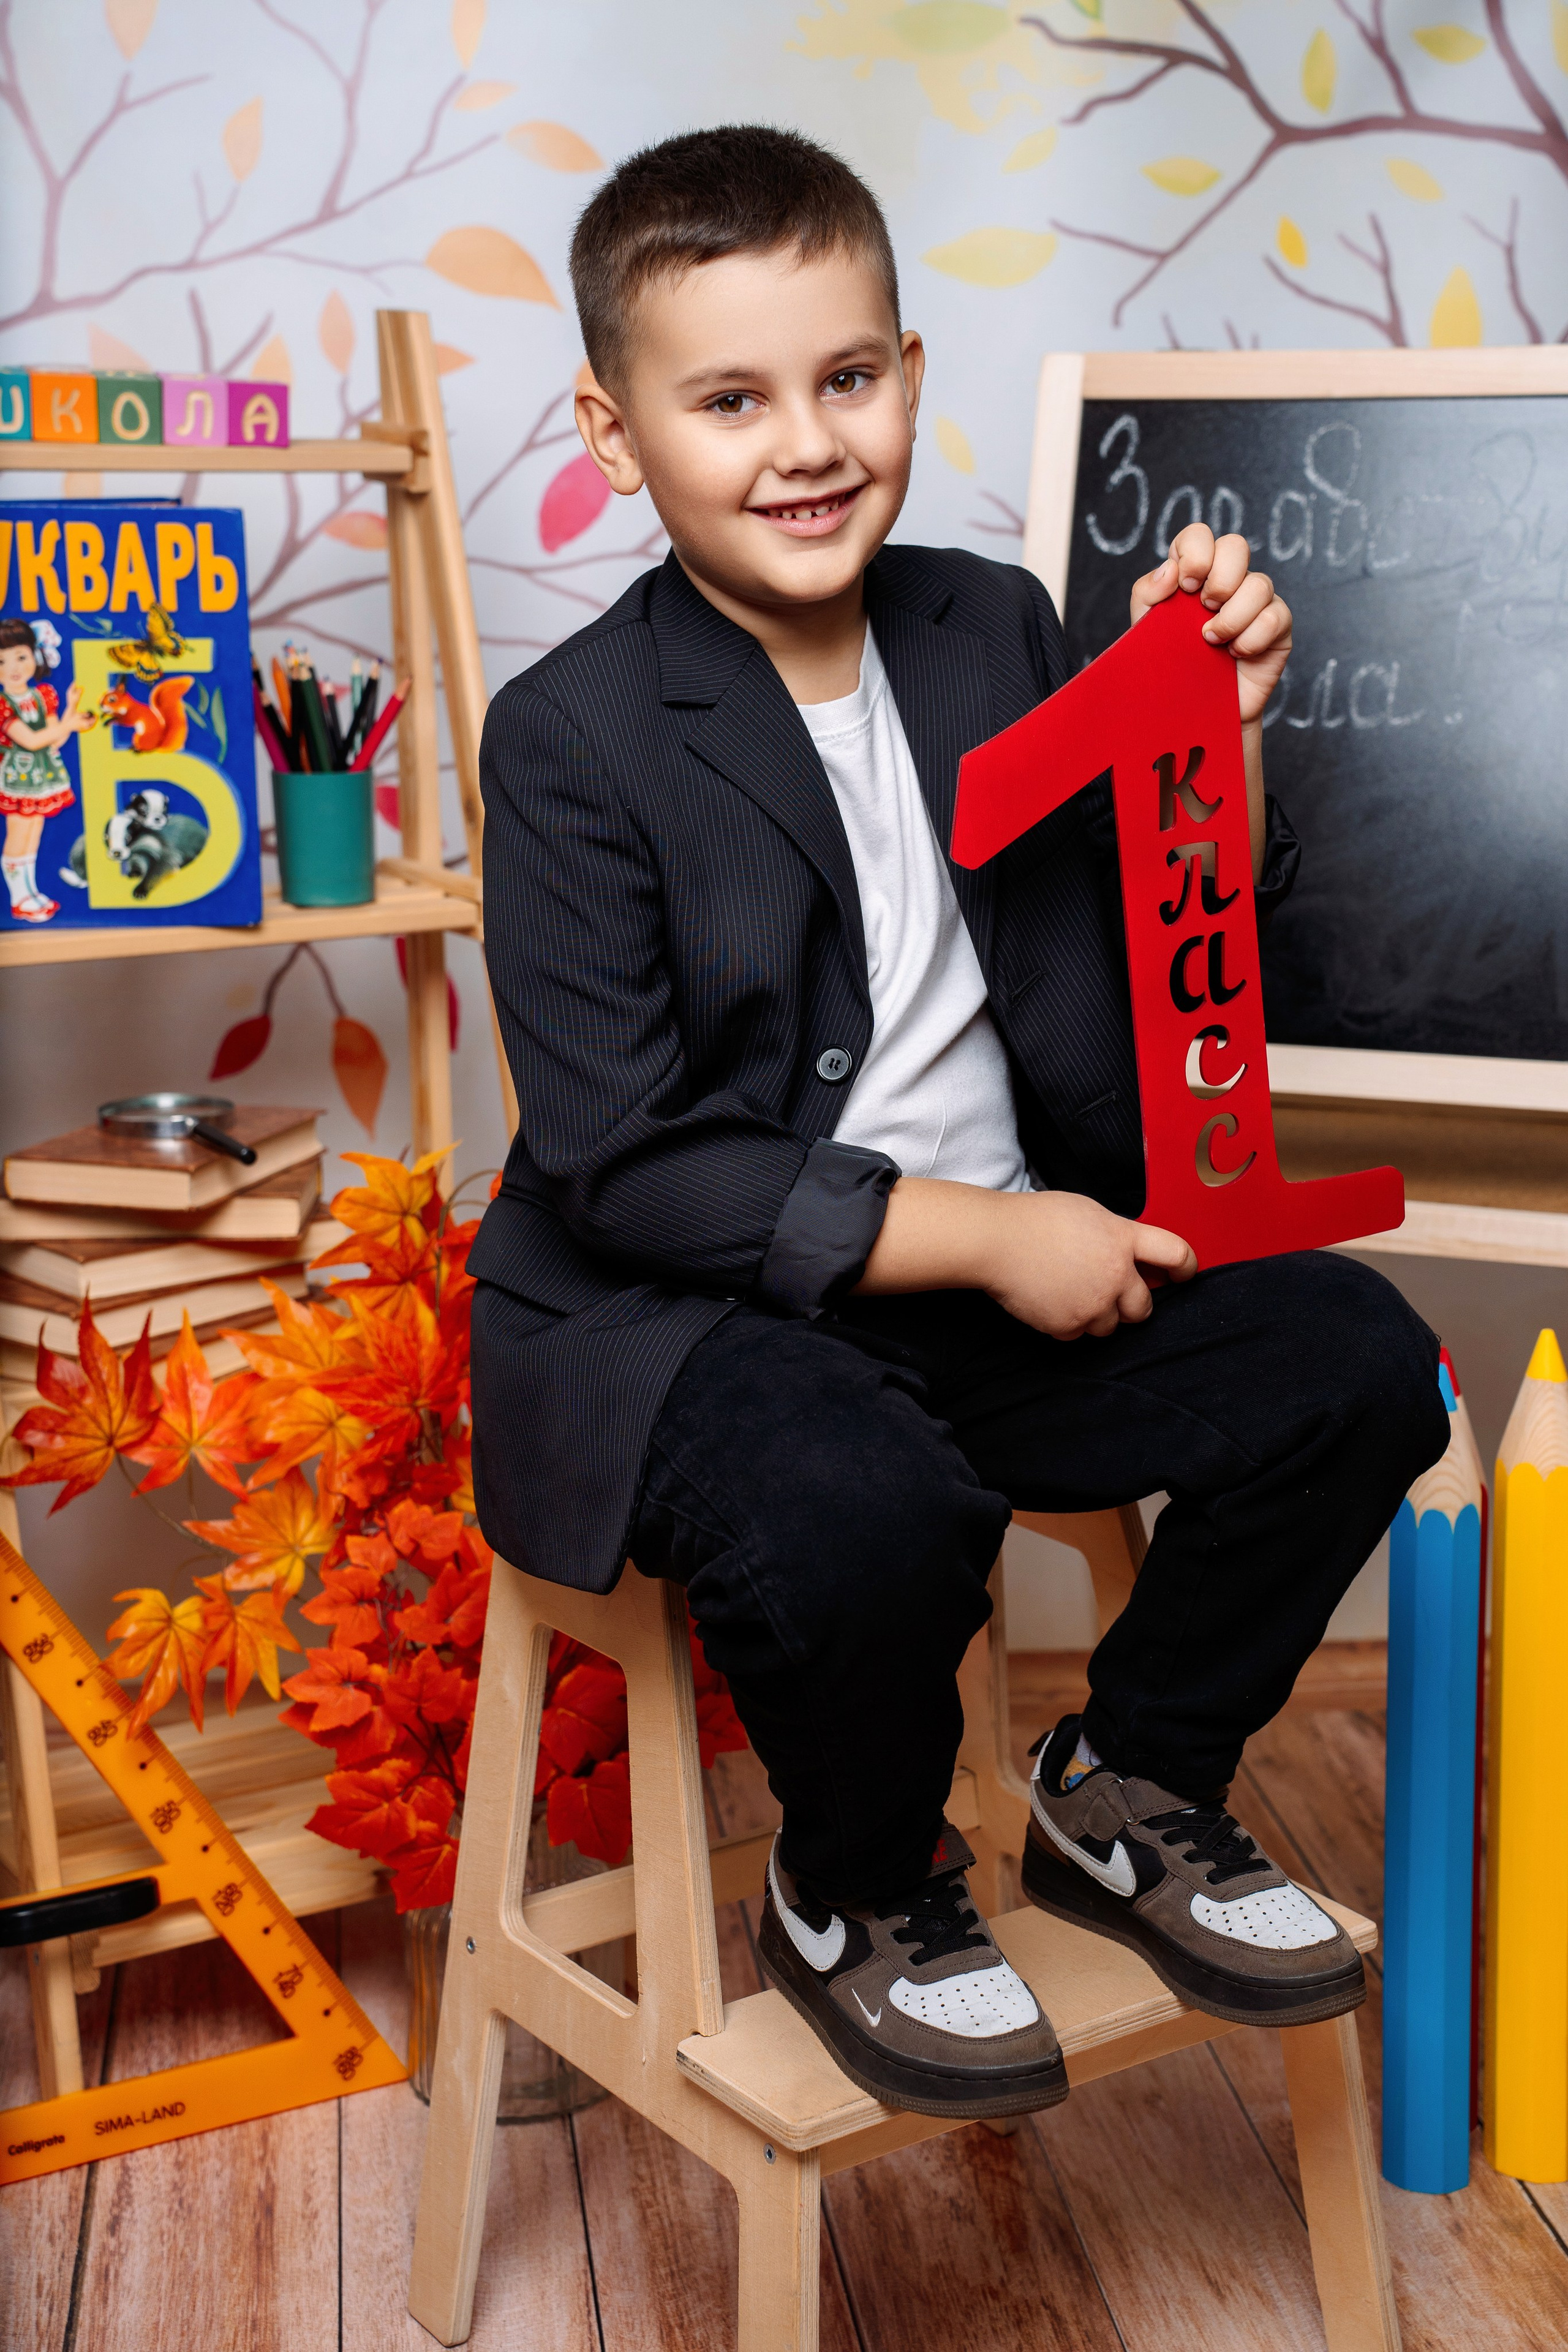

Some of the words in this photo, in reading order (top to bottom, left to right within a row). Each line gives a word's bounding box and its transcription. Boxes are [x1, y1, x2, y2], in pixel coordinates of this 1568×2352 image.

[1153, 745, 1258, 1188] класс
[94, 2101, 186, 2136] SIMA-LAND
[7, 2134, 66, 2156] Calligrata
